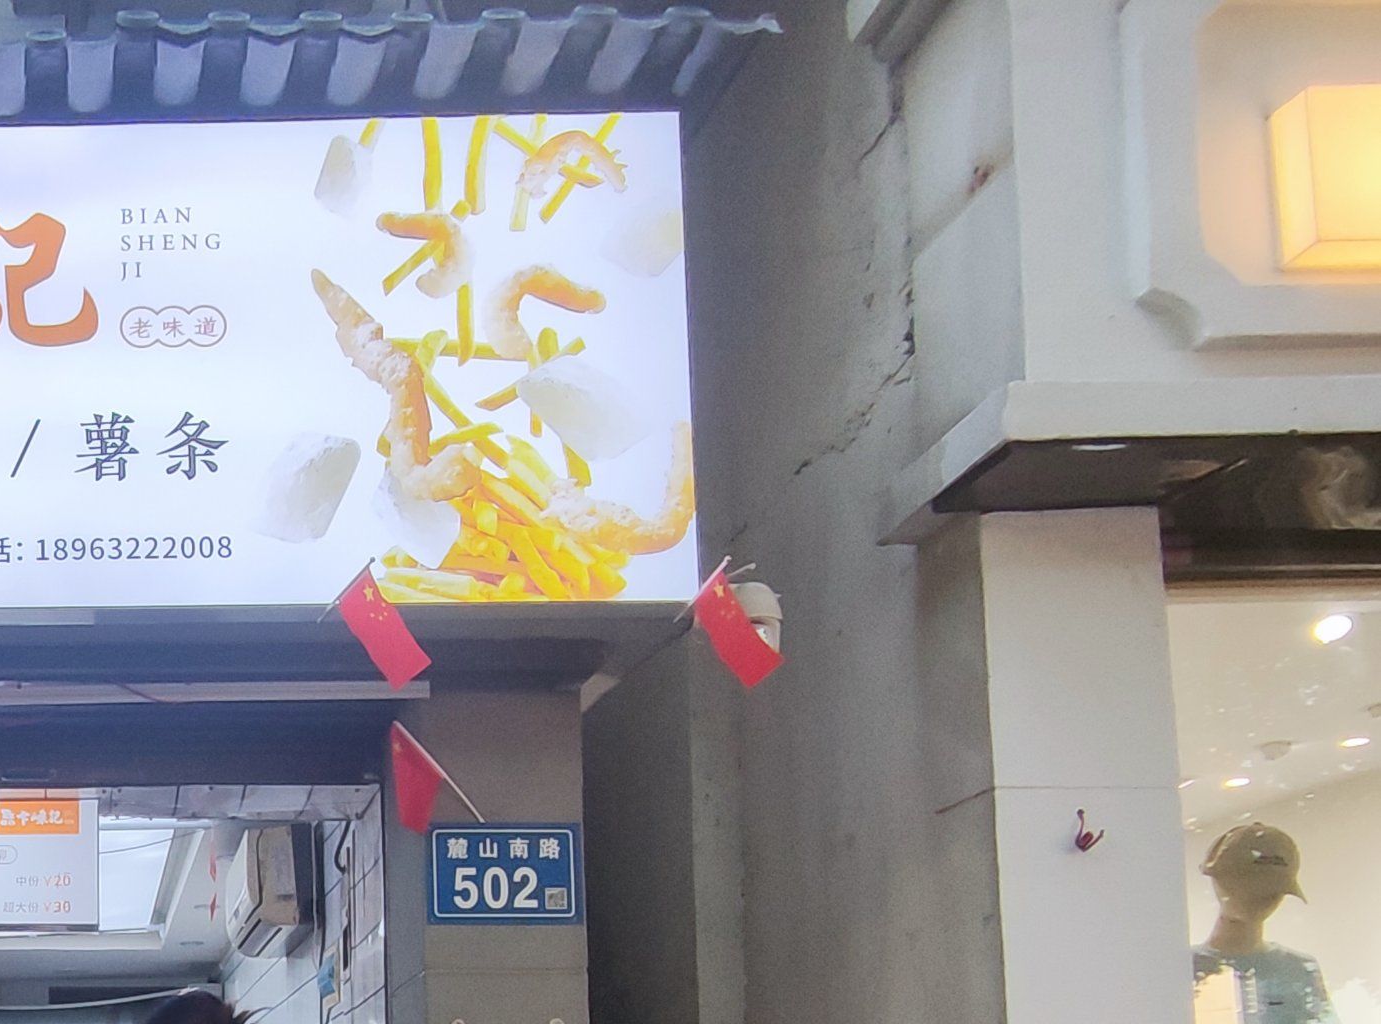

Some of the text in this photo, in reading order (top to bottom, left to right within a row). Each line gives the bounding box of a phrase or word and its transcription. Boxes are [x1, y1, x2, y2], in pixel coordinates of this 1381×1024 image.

[121, 207, 191, 225] BIAN
[121, 233, 221, 252] SHENG
[121, 262, 142, 281] JI
[129, 316, 218, 338] 老味道
[447, 837, 561, 860] 麓山南路
[453, 866, 539, 910] 502
